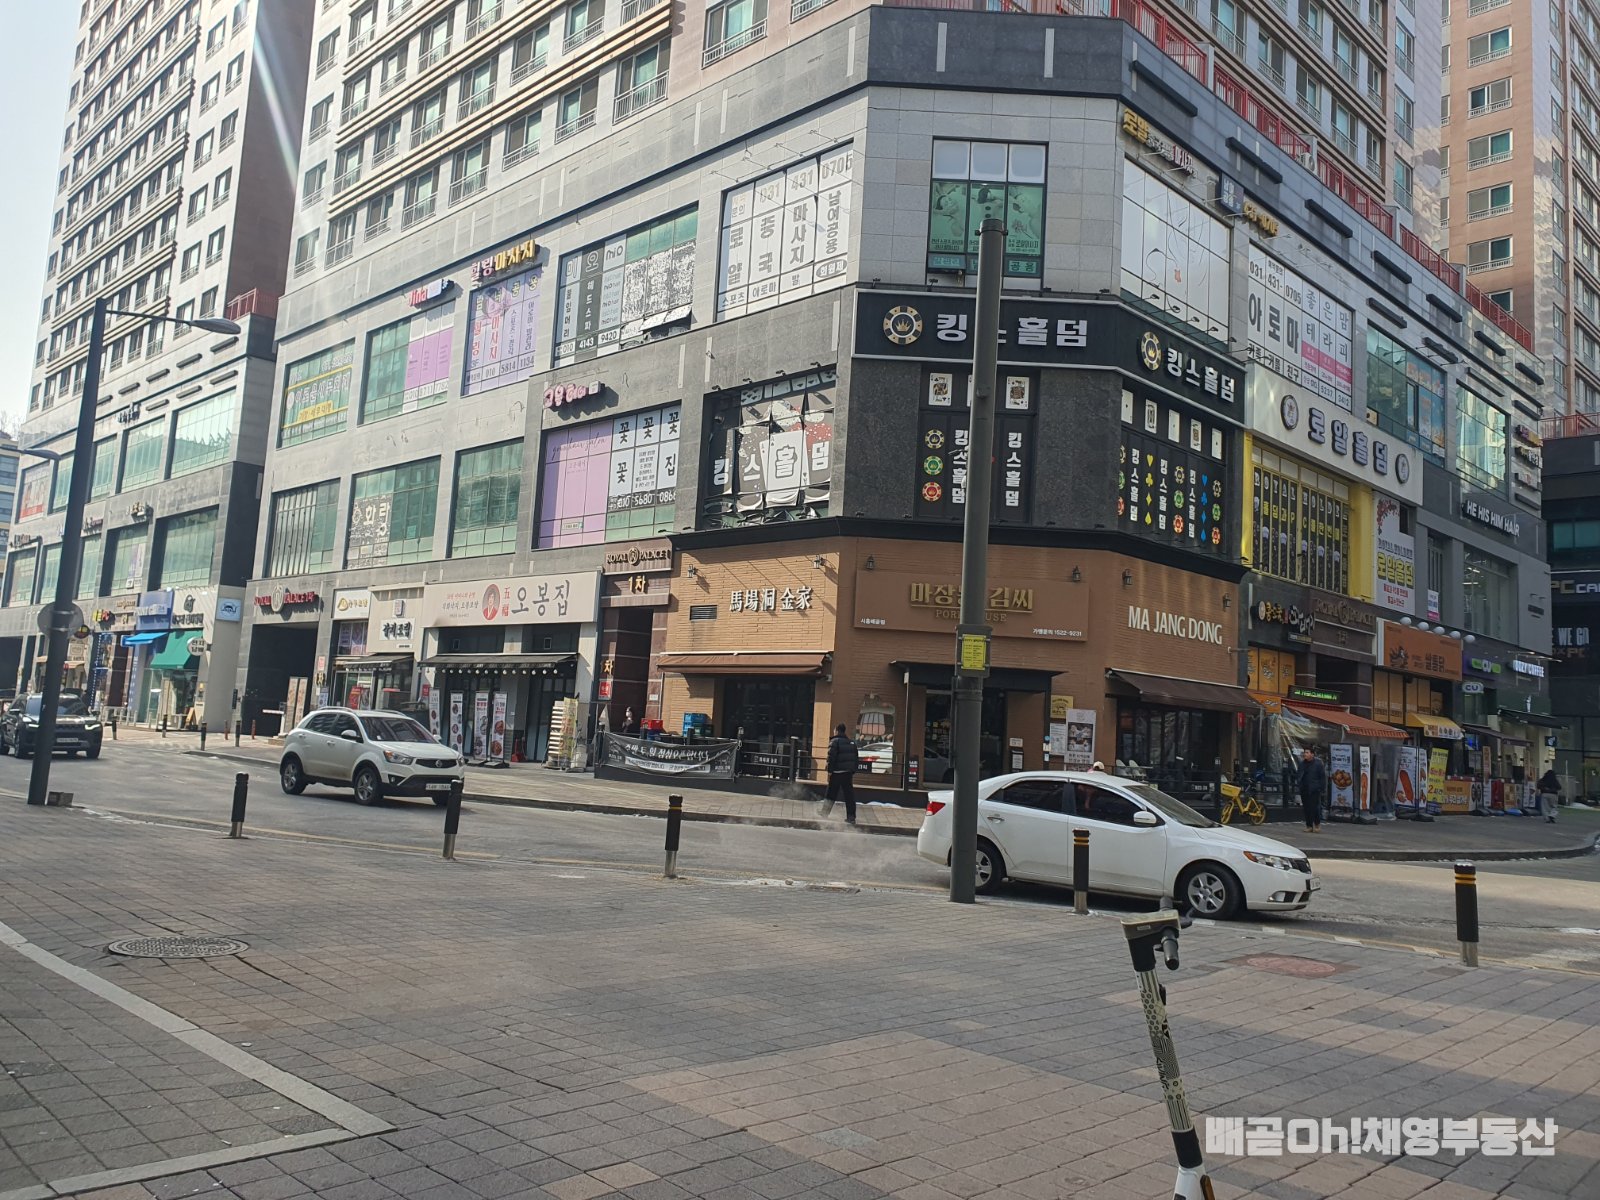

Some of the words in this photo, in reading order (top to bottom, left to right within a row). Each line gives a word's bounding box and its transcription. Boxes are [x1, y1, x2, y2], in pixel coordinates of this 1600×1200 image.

[791, 170, 813, 191] 431
[822, 154, 852, 180] 0705
[790, 203, 808, 264] 마사지
[1250, 261, 1263, 280] 031
[489, 316, 499, 361] 마사지
[579, 337, 594, 349] 4143
[601, 331, 618, 343] 9420
[937, 314, 1088, 348] 킹홀덤
[1250, 293, 1299, 354] 아로마
[1306, 323, 1348, 363] 테라피
[1167, 347, 1235, 403] 킹스홀덤
[619, 421, 630, 444] 꽃
[643, 416, 654, 439] 꽃
[668, 411, 680, 435] 꽃
[1308, 407, 1388, 476] 로얄홀덤
[617, 461, 628, 484] 꽃
[665, 453, 676, 476] 집
[714, 442, 830, 486] 킹스홀덤
[1006, 432, 1022, 507] 킹스홀덤
[635, 493, 652, 506] 5680
[1130, 449, 1139, 522] 킹스홀덤
[1467, 500, 1477, 517] HE
[1478, 505, 1490, 523] HIS
[1490, 511, 1504, 530] HIM
[1504, 518, 1520, 537] HAIR
[606, 552, 628, 564] ROYAL
[639, 550, 664, 561] PALACE
[1377, 552, 1414, 590] 로얄홀덤
[511, 579, 570, 618] 오봉집
[628, 575, 646, 593] 1차
[730, 588, 776, 612] 馬場洞
[780, 585, 813, 611] 金家
[990, 586, 1034, 610] 김씨
[1576, 583, 1600, 594] CA
[1128, 605, 1150, 632] MA
[1153, 611, 1186, 638] JANG
[1188, 618, 1222, 645] DONG
[1558, 627, 1573, 647] WE
